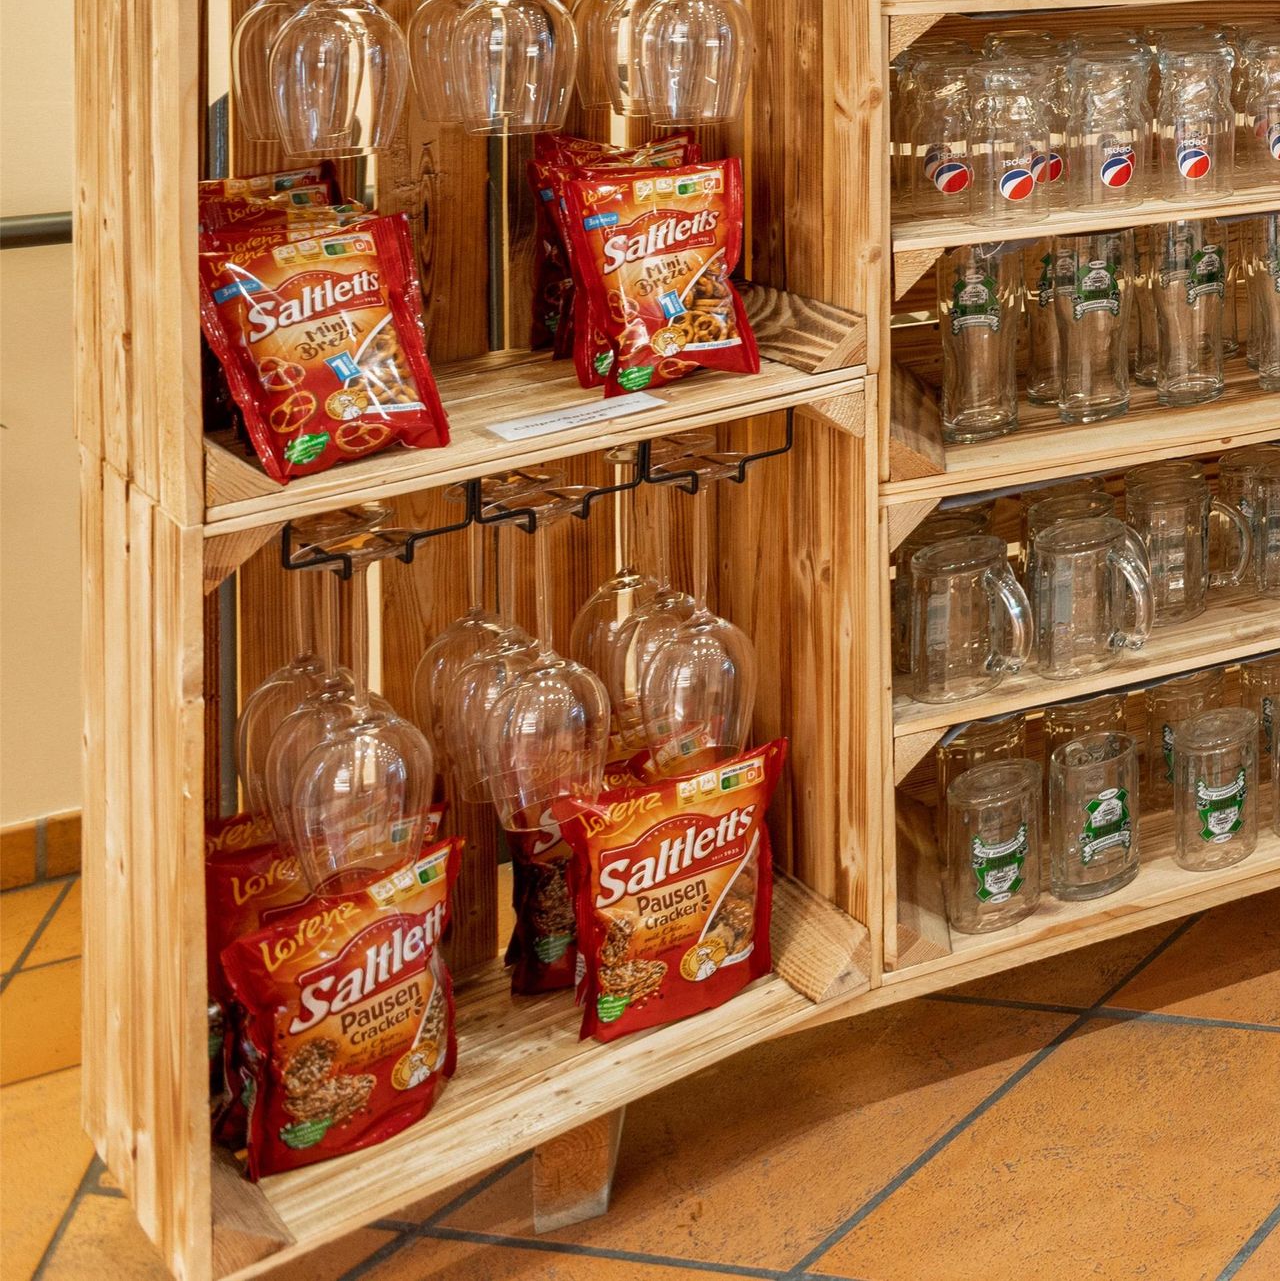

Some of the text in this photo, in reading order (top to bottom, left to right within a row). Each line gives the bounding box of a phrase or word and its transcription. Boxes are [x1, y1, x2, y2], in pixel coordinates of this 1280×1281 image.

[583, 184, 630, 206] Lorenz
[603, 209, 720, 274] Saltletts
[634, 261, 694, 296] Brezel
[645, 255, 681, 279] Mini
[248, 270, 379, 344] Saltletts
[294, 323, 365, 361] Brezel
[305, 319, 347, 344] Mini
[578, 792, 663, 838] Lorenz
[595, 804, 757, 908] Saltletts
[636, 880, 708, 917] Pausen
[645, 901, 700, 931] Cracker
[259, 898, 362, 972] Lorenz
[341, 981, 421, 1036] Pausen
[350, 1006, 412, 1047] Cracker
